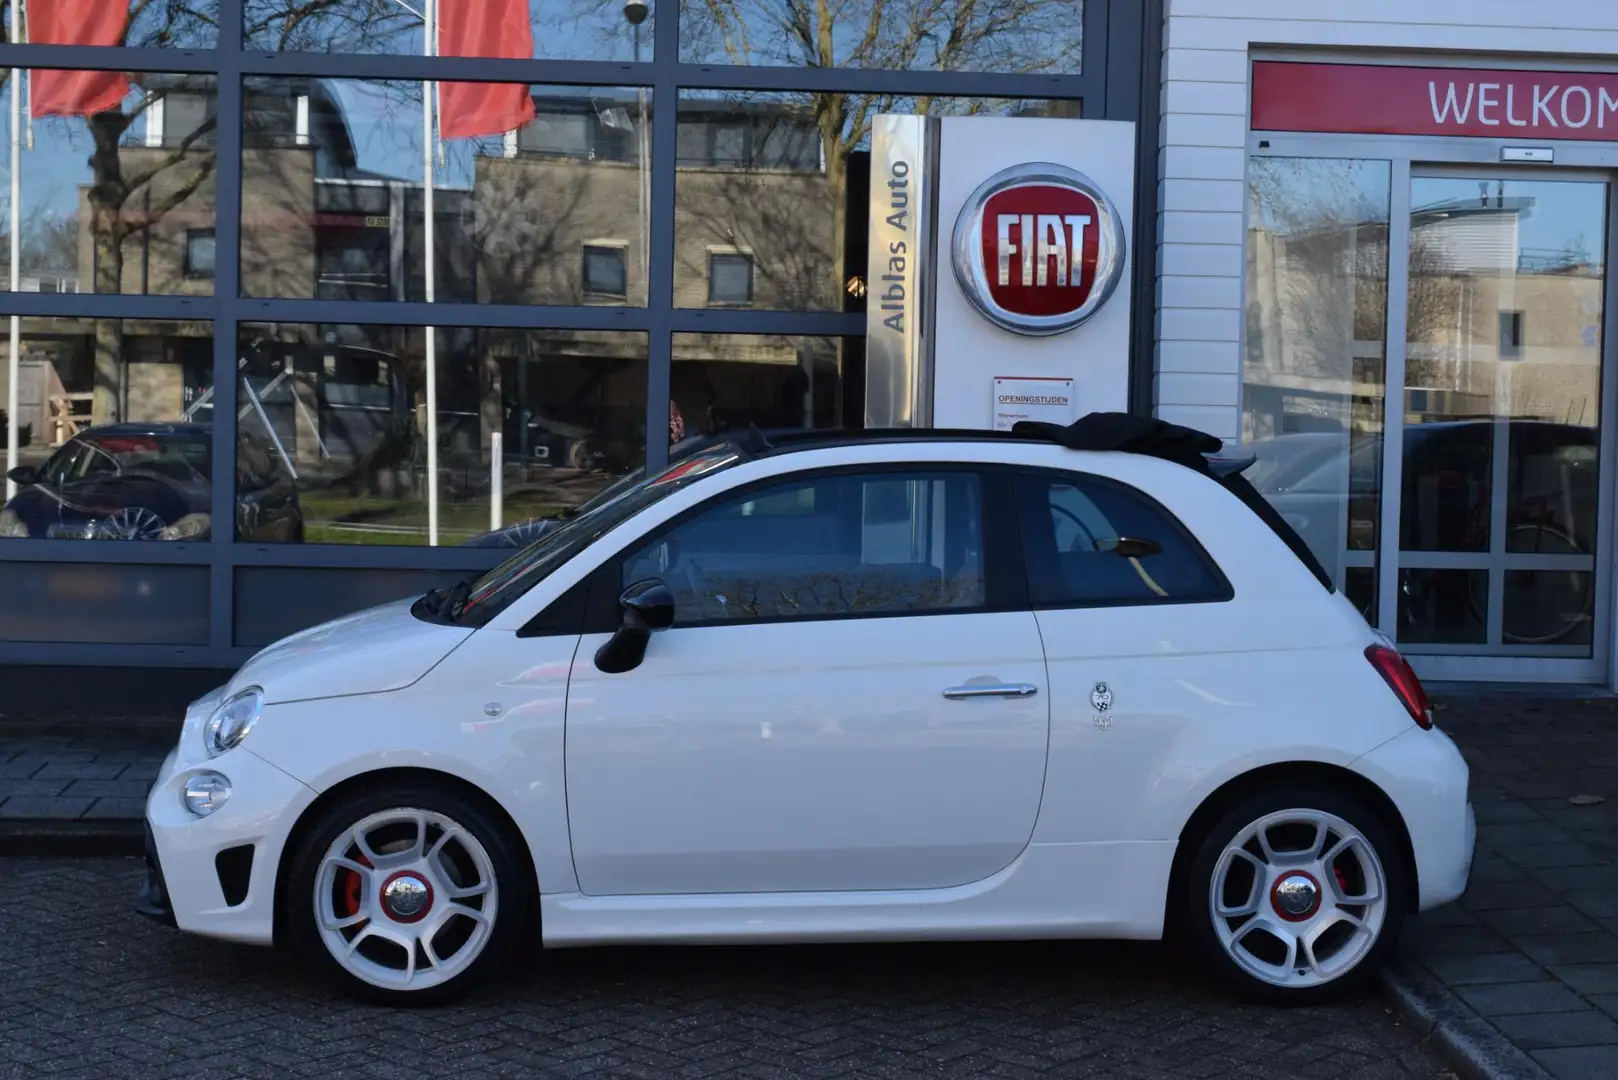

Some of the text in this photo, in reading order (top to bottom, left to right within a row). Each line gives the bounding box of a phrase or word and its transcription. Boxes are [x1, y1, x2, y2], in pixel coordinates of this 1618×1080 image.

[881, 160, 909, 334] Alblas Auto
[997, 214, 1091, 287] FIAT
[998, 394, 1068, 404] OPENINGSTIJDEN
